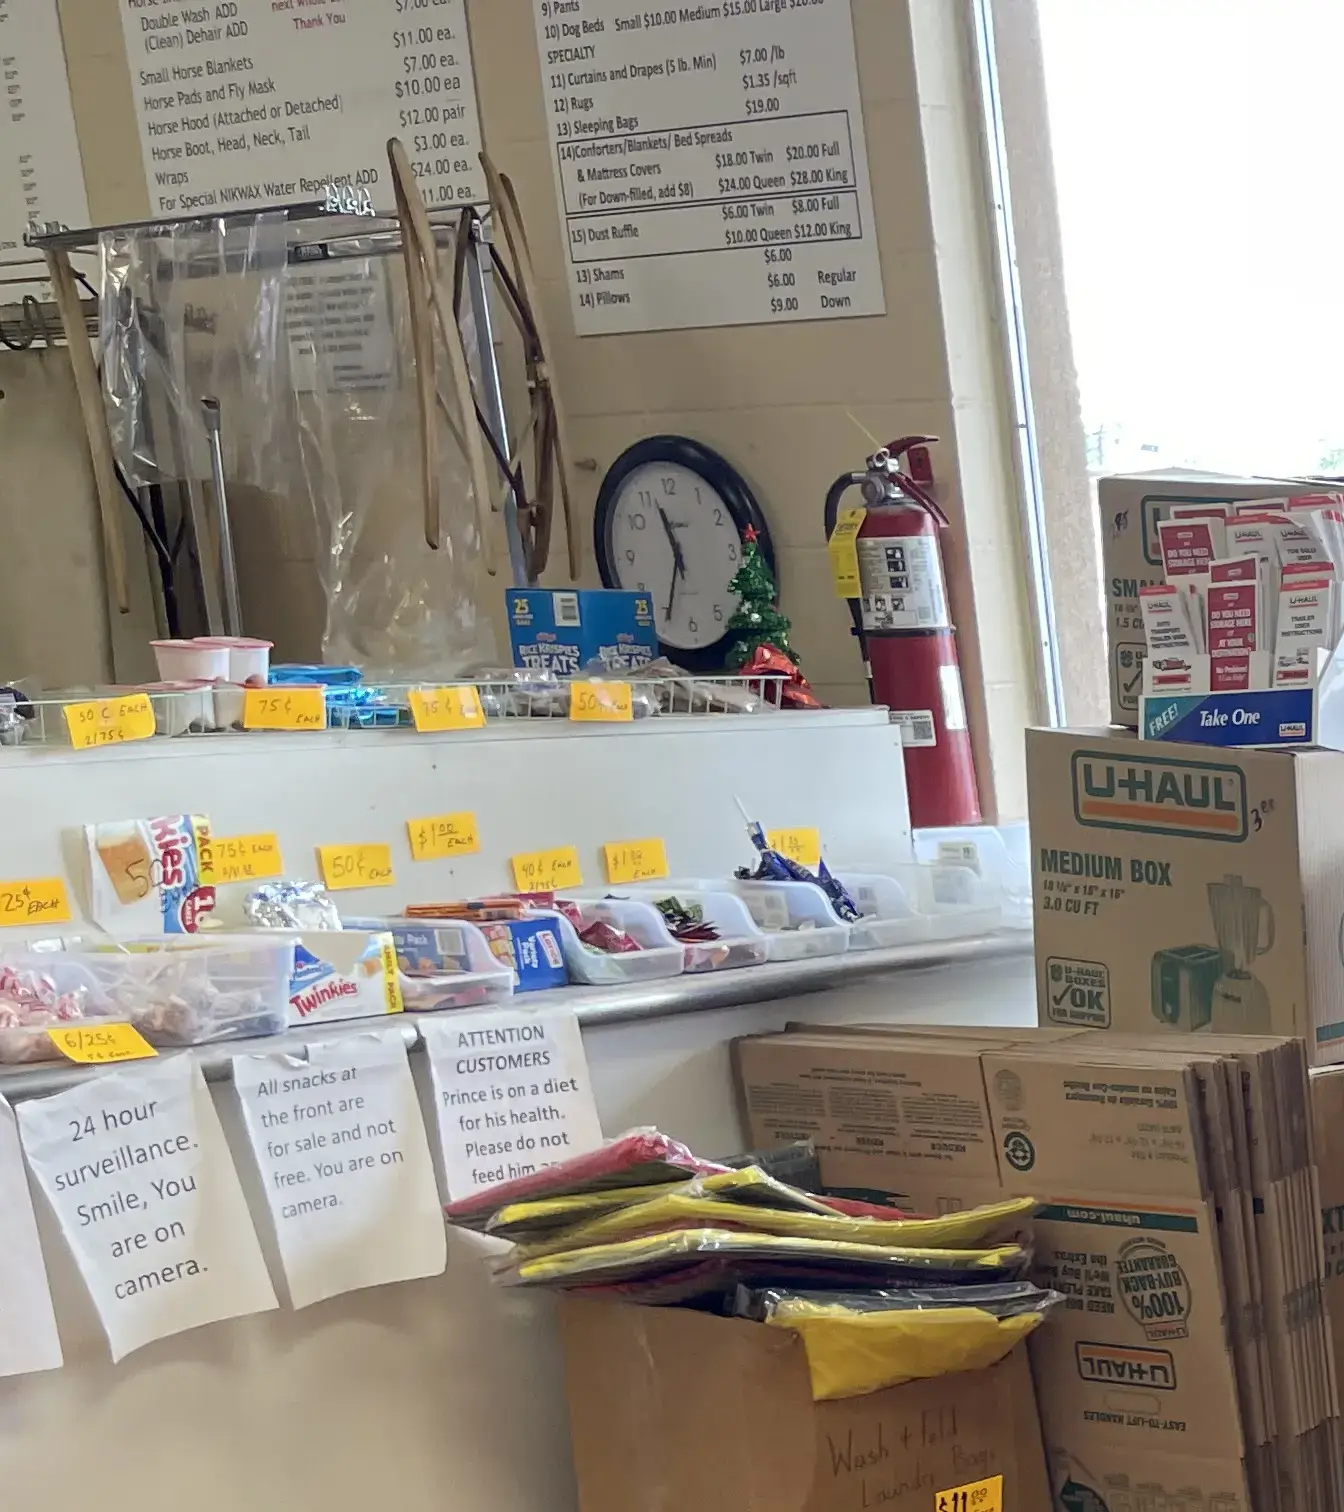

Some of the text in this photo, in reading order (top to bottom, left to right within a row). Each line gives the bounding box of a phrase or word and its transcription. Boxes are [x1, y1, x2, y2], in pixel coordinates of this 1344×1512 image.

[141, 2, 238, 32] Double Wash ADD
[293, 12, 346, 30] Thank You
[545, 18, 605, 41] 10) Dog Beds
[145, 21, 248, 54] (Clean) Dehair ADD
[548, 45, 595, 64] SPECIALTY
[140, 56, 254, 86] Small Horse Blankets
[743, 69, 797, 91] $1.35 /sqft
[400, 104, 466, 128] $12.00 pair
[554, 97, 593, 114] 12) Rugs
[745, 97, 780, 115] $19.00
[557, 116, 638, 137] 13) Sleeping Bags
[715, 141, 840, 169] $18.00 Twin $20.00 Full
[156, 170, 189, 188] Wraps
[718, 168, 848, 194] $24.00 Queen $28.00 King
[722, 196, 839, 220] $6.00 Twin $8.00 Full
[726, 222, 852, 246] $10.00 Queen $12.00 King
[764, 248, 792, 264] $6.00
[768, 268, 857, 288] $6.00 Regular
[770, 295, 851, 313] $9.00 Down
[522, 655, 580, 672] TREATS
[1149, 702, 1178, 736] FREE!
[1200, 709, 1260, 726] Take One
[1083, 763, 1236, 811] U-HAUL
[196, 825, 214, 873] PACK
[1041, 848, 1172, 887] MEDIUM BOX
[1043, 896, 1100, 917] 3.0 CU FT
[1064, 975, 1106, 988] BOXES
[290, 977, 358, 1017] Twinkies
[1070, 989, 1105, 1011] OK
[458, 1025, 544, 1048] ATTENTION
[456, 1051, 550, 1074] CUSTOMERS
[257, 1066, 357, 1098] All snacks at
[443, 1078, 579, 1107] Prince is on a diet
[69, 1101, 158, 1142] 24 hour
[261, 1096, 365, 1128] the front are
[459, 1105, 565, 1132] for his health.
[267, 1119, 396, 1158] for sale and not
[466, 1132, 569, 1158] Please do not
[55, 1135, 199, 1191] surveillance.
[274, 1149, 403, 1189] free. You are on
[472, 1163, 536, 1184] feed him
[77, 1174, 196, 1227] Smile, You
[282, 1194, 344, 1219] camera.
[1067, 1208, 1140, 1225] uhaul.com
[111, 1221, 185, 1258] are on
[115, 1258, 208, 1300] camera.
[1123, 1271, 1182, 1293] BUY-BACK
[1132, 1291, 1184, 1320] 100%
[1083, 1357, 1169, 1383] U-HAUL
[826, 1421, 889, 1478] Wash
